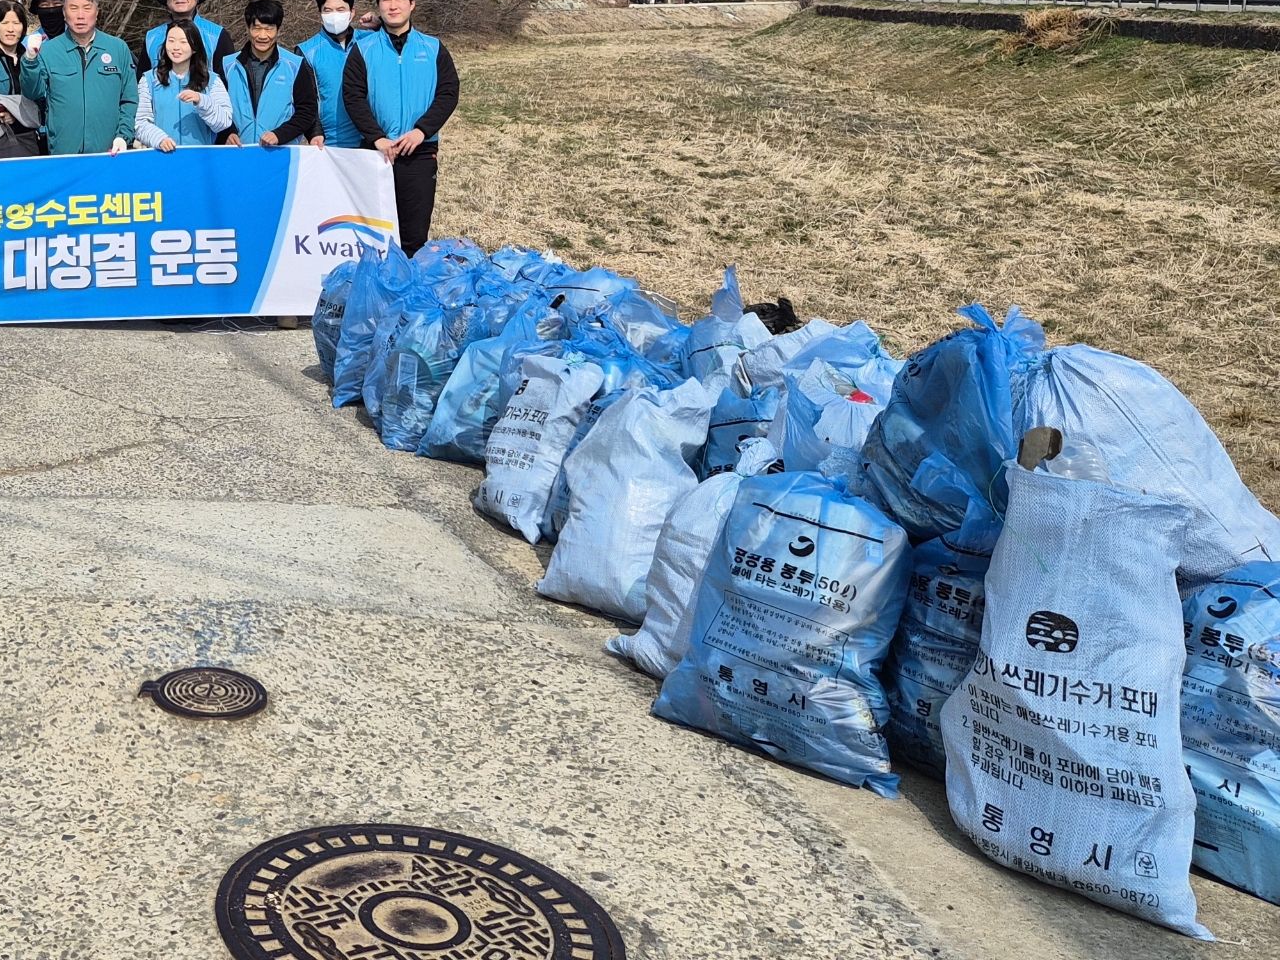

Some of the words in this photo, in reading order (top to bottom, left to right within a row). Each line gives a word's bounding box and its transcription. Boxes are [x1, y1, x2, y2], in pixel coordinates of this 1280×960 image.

[3, 231, 138, 291] 대청결
[150, 228, 238, 286] 운동
[294, 234, 313, 255] K
[319, 239, 386, 260] watr
[733, 546, 776, 574] 공공용
[755, 571, 777, 588] 타는
[780, 581, 814, 602] 쓰레기
[819, 593, 851, 614] 전용)
[936, 600, 975, 625] 쓰레기
[1200, 648, 1250, 674] 쓰레기
[718, 664, 734, 682] 통
[752, 678, 768, 696] 영
[787, 692, 806, 711] 시
[1001, 662, 1113, 709] 쓰레기수거
[1120, 686, 1158, 719] 포대
[916, 698, 932, 717] 영
[967, 683, 978, 699] 이
[980, 688, 1013, 715] 포대는
[1016, 704, 1130, 743] 해양쓰레기수거용
[1135, 730, 1158, 749] 포대
[970, 752, 1026, 791] 부과됩니다.
[972, 736, 981, 752] 할
[984, 741, 1005, 763] 경우
[1008, 755, 1054, 786] 100만원
[1060, 775, 1104, 799] 이하의
[1056, 756, 1100, 781] 포대에
[1106, 767, 1135, 786] 담아
[1138, 773, 1162, 793] 배출
[1216, 778, 1242, 799] 시
[982, 802, 1004, 833] 통
[1030, 826, 1055, 857] 영
[1082, 843, 1113, 871] 시
[1086, 883, 1160, 908] 650-0872)
